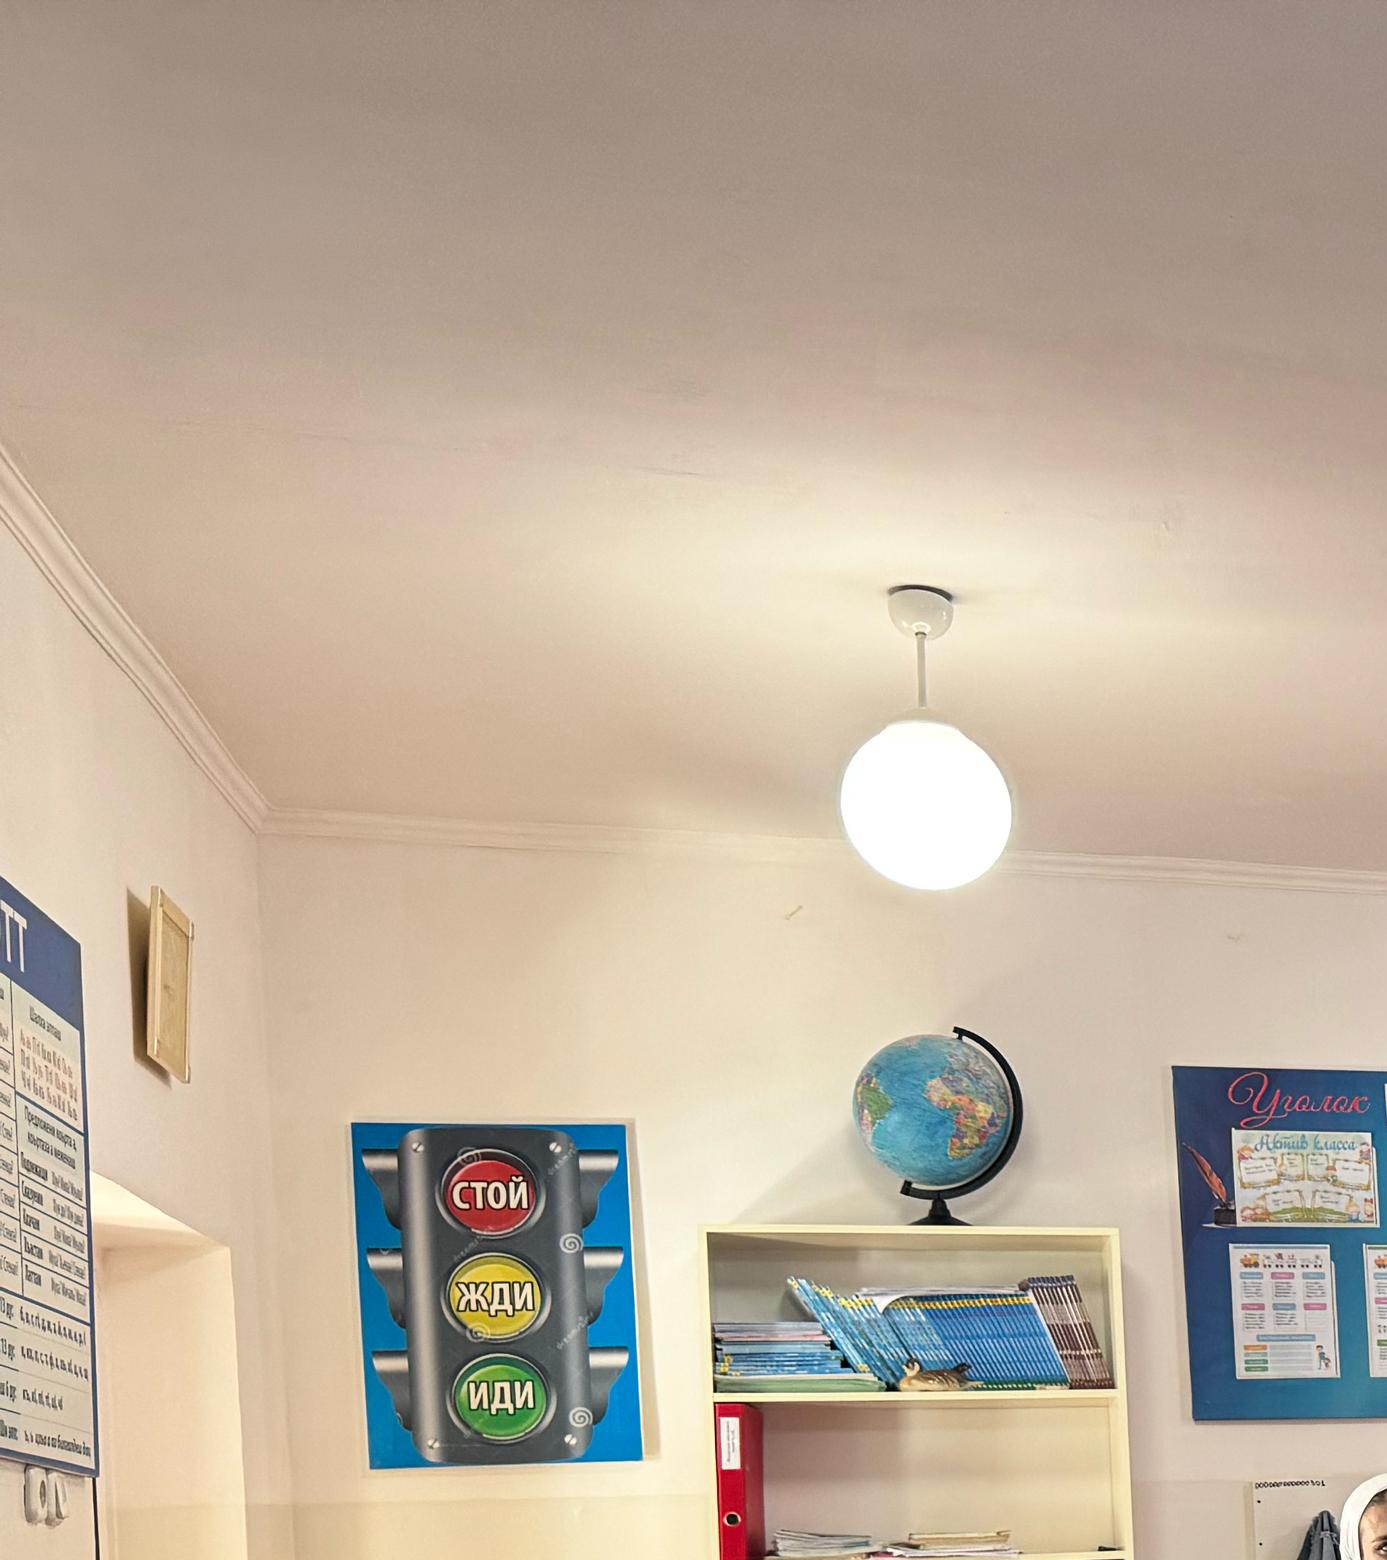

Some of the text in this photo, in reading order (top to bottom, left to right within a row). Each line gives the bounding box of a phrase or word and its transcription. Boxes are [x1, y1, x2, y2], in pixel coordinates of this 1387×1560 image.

[1228, 1071, 1371, 1129] Уголок
[1254, 1133, 1358, 1153] Актив класса
[451, 1175, 530, 1211] СТОЙ
[456, 1281, 535, 1318] ЖДИ
[467, 1380, 535, 1416] ИДИ
